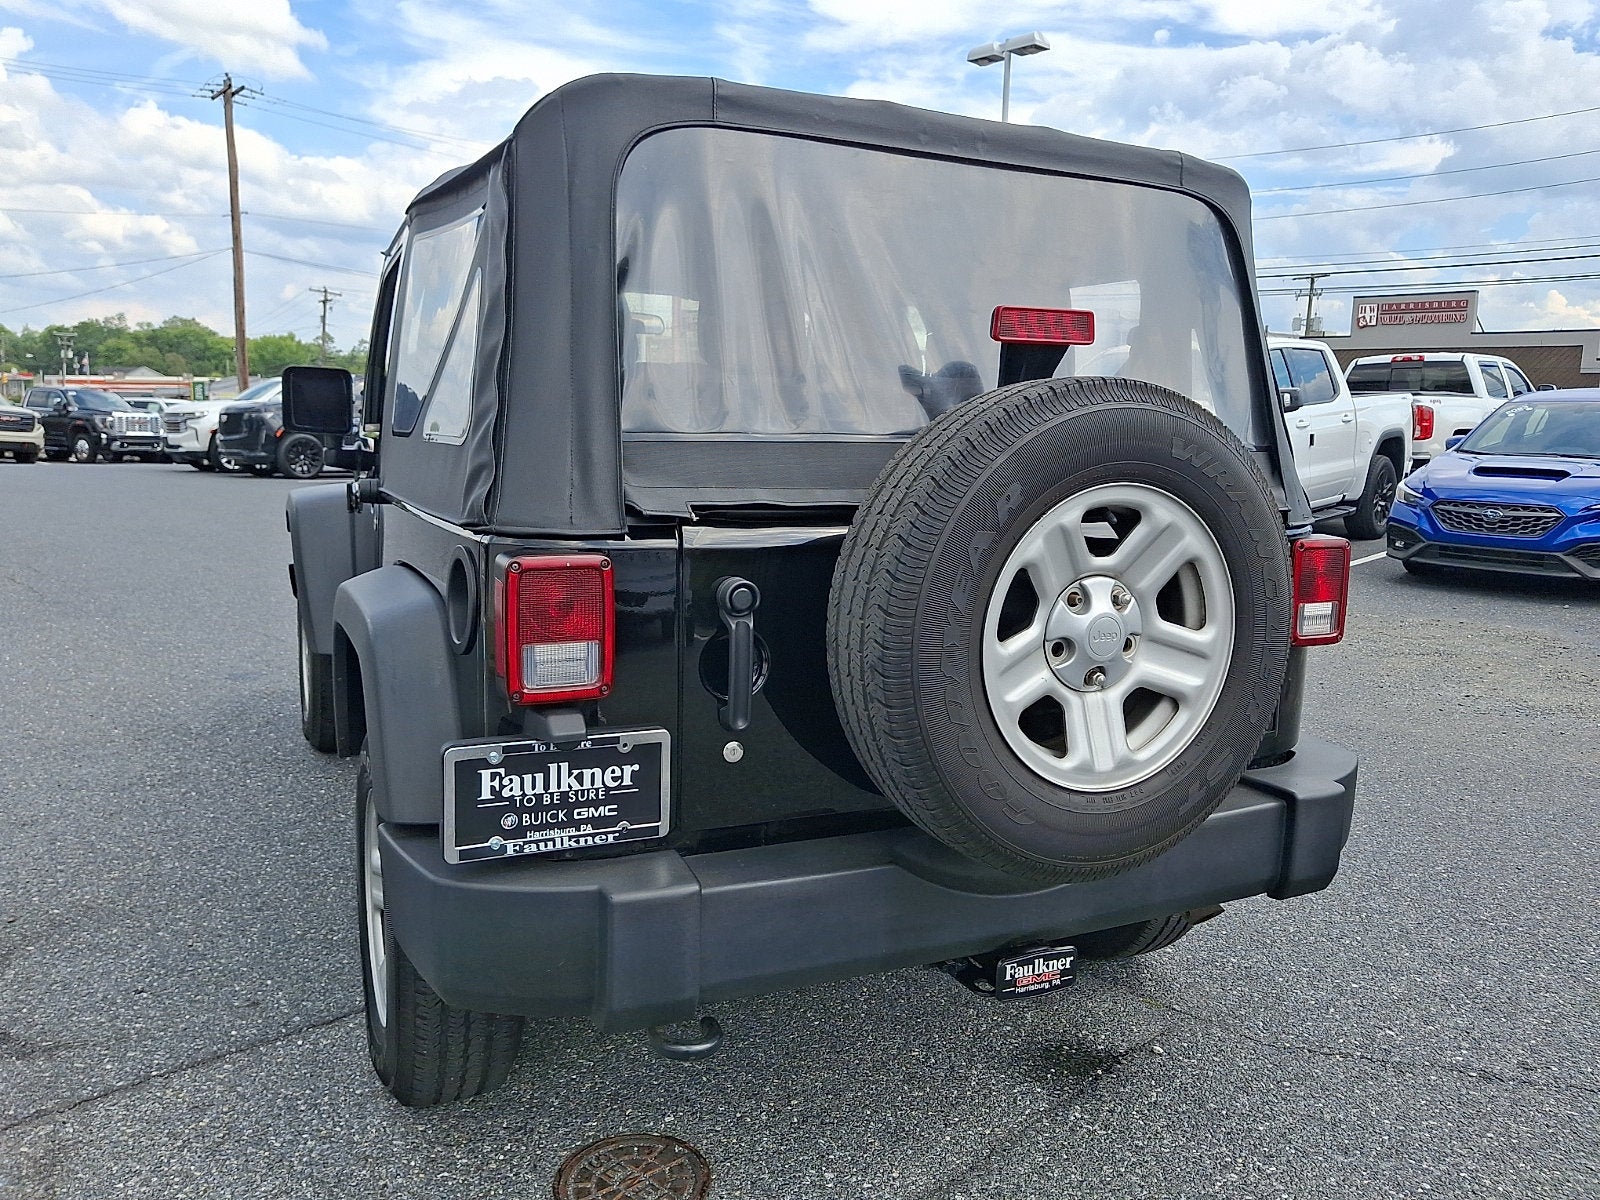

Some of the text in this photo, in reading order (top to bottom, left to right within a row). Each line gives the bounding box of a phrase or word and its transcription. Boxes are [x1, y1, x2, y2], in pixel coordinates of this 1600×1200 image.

[1382, 300, 1467, 311] HARRISBURG
[1171, 436, 1279, 723] WRANGLER
[1092, 630, 1118, 643] Jeep
[940, 482, 1037, 825] GOODYEAR
[532, 743, 546, 752] To
[477, 761, 640, 801] Faulkner
[514, 788, 606, 808] TO BE SURE
[522, 804, 618, 826] BUICK GMC
[580, 823, 593, 833] PA
[504, 832, 620, 856] Faulkner
[1004, 956, 1074, 981] Faulkner
[1016, 969, 1061, 987] GMC
[1052, 978, 1061, 987] PA
